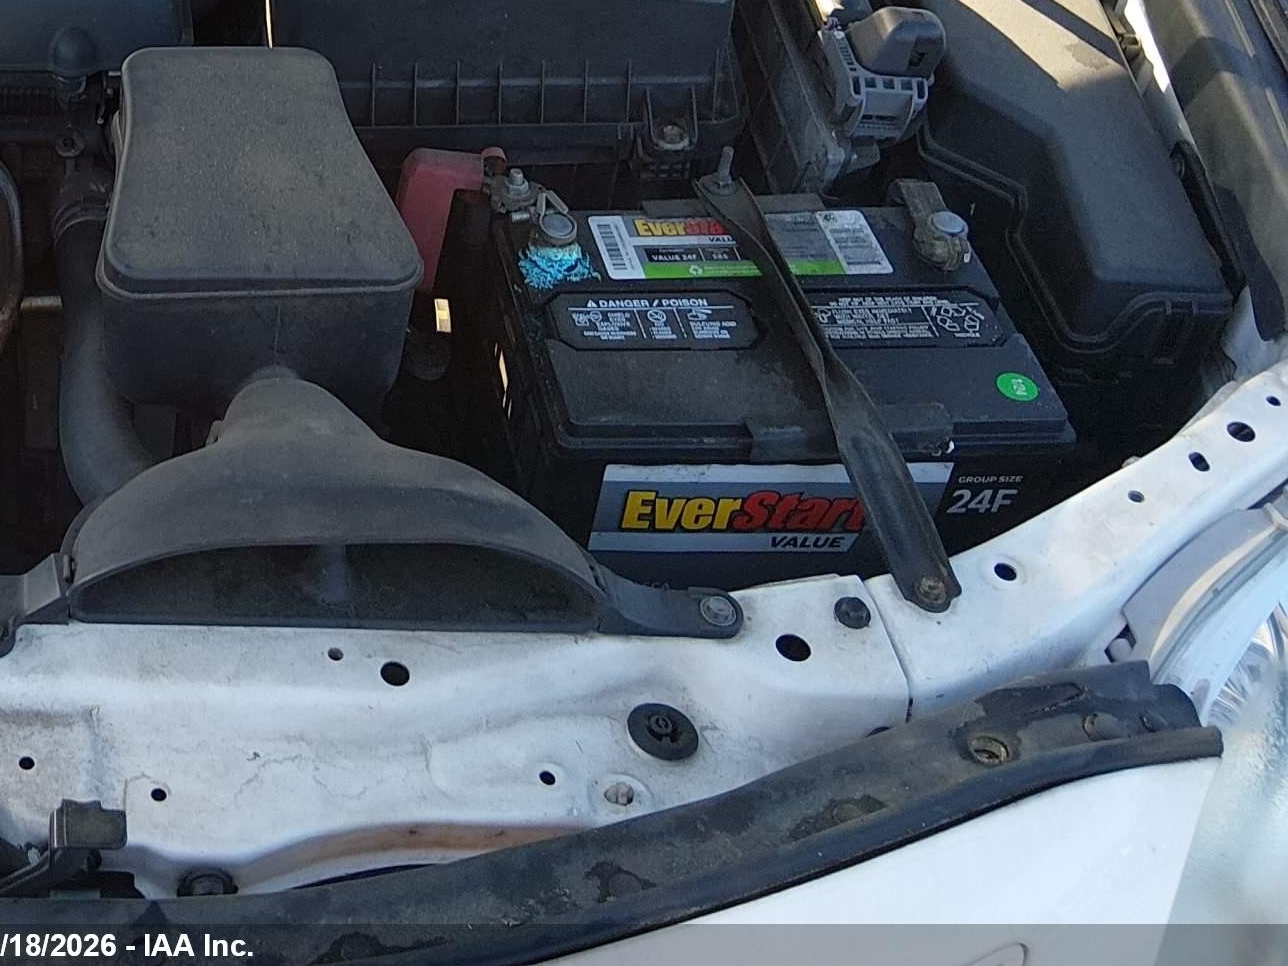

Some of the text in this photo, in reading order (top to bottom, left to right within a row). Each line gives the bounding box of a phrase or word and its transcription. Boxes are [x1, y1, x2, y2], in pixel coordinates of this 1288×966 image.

[598, 299, 650, 308] DANGER
[662, 298, 708, 307] POISON
[998, 475, 1024, 483] SIZE
[946, 488, 1019, 514] 24F
[770, 536, 845, 549] VALUE
